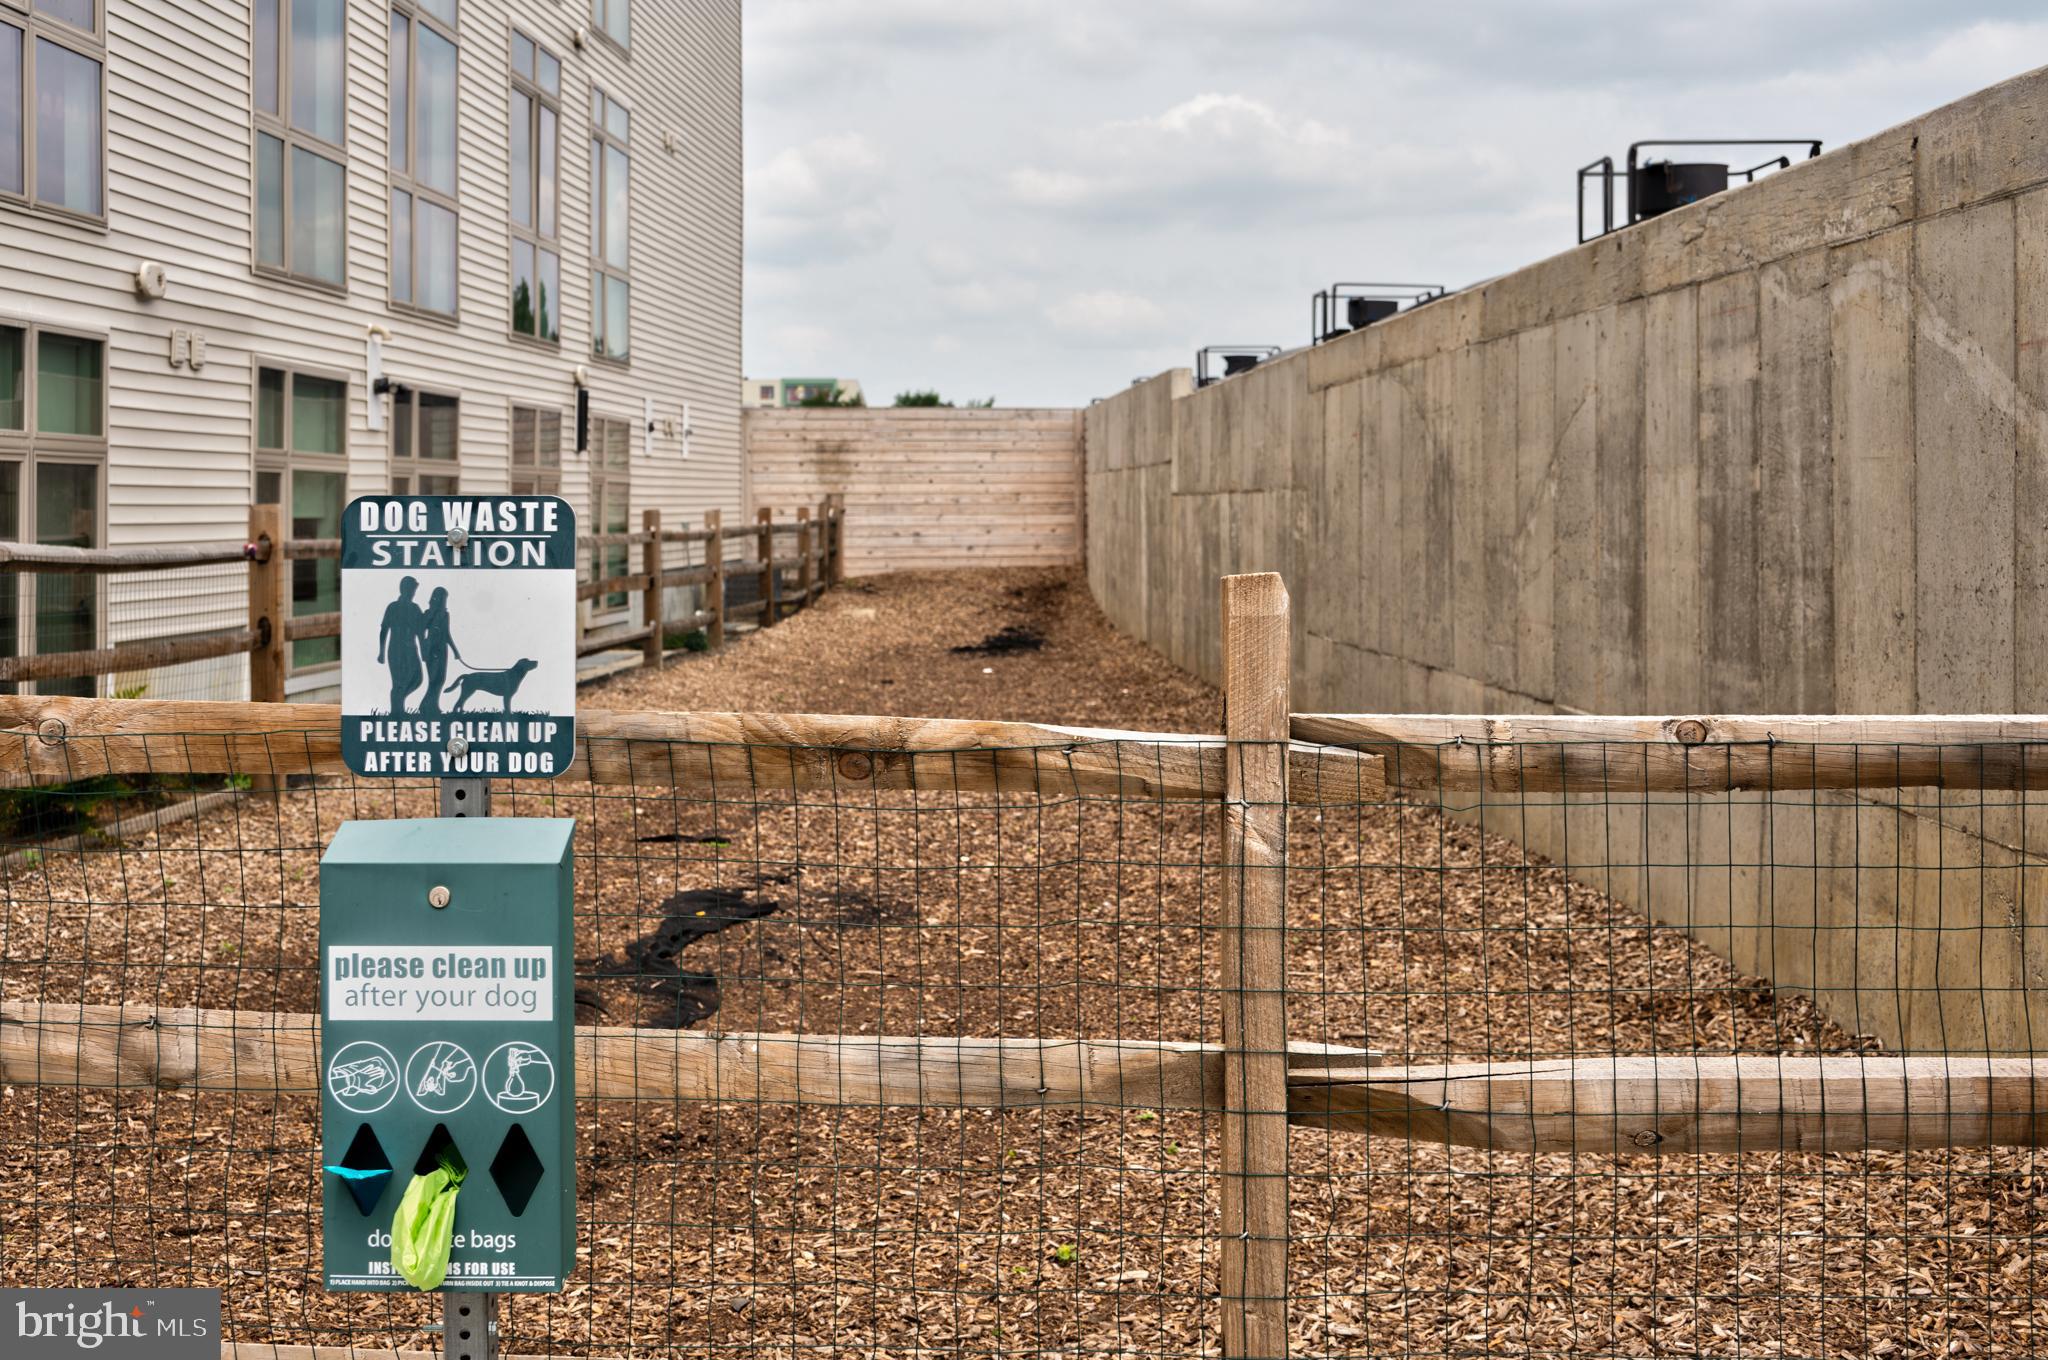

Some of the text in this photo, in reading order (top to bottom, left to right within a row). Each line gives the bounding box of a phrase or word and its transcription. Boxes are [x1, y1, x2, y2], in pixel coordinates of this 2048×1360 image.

[360, 500, 559, 532] DOG WASTE
[372, 540, 546, 567] STATION
[360, 721, 558, 743] PLEASE CLEAN UP
[364, 751, 554, 773] AFTER YOUR DOG
[335, 953, 547, 981] please clean up
[345, 982, 538, 1013] after your dog
[367, 1229, 392, 1248] do
[471, 1229, 517, 1253] bags
[464, 1262, 488, 1275] FOR
[492, 1262, 516, 1275] USE
